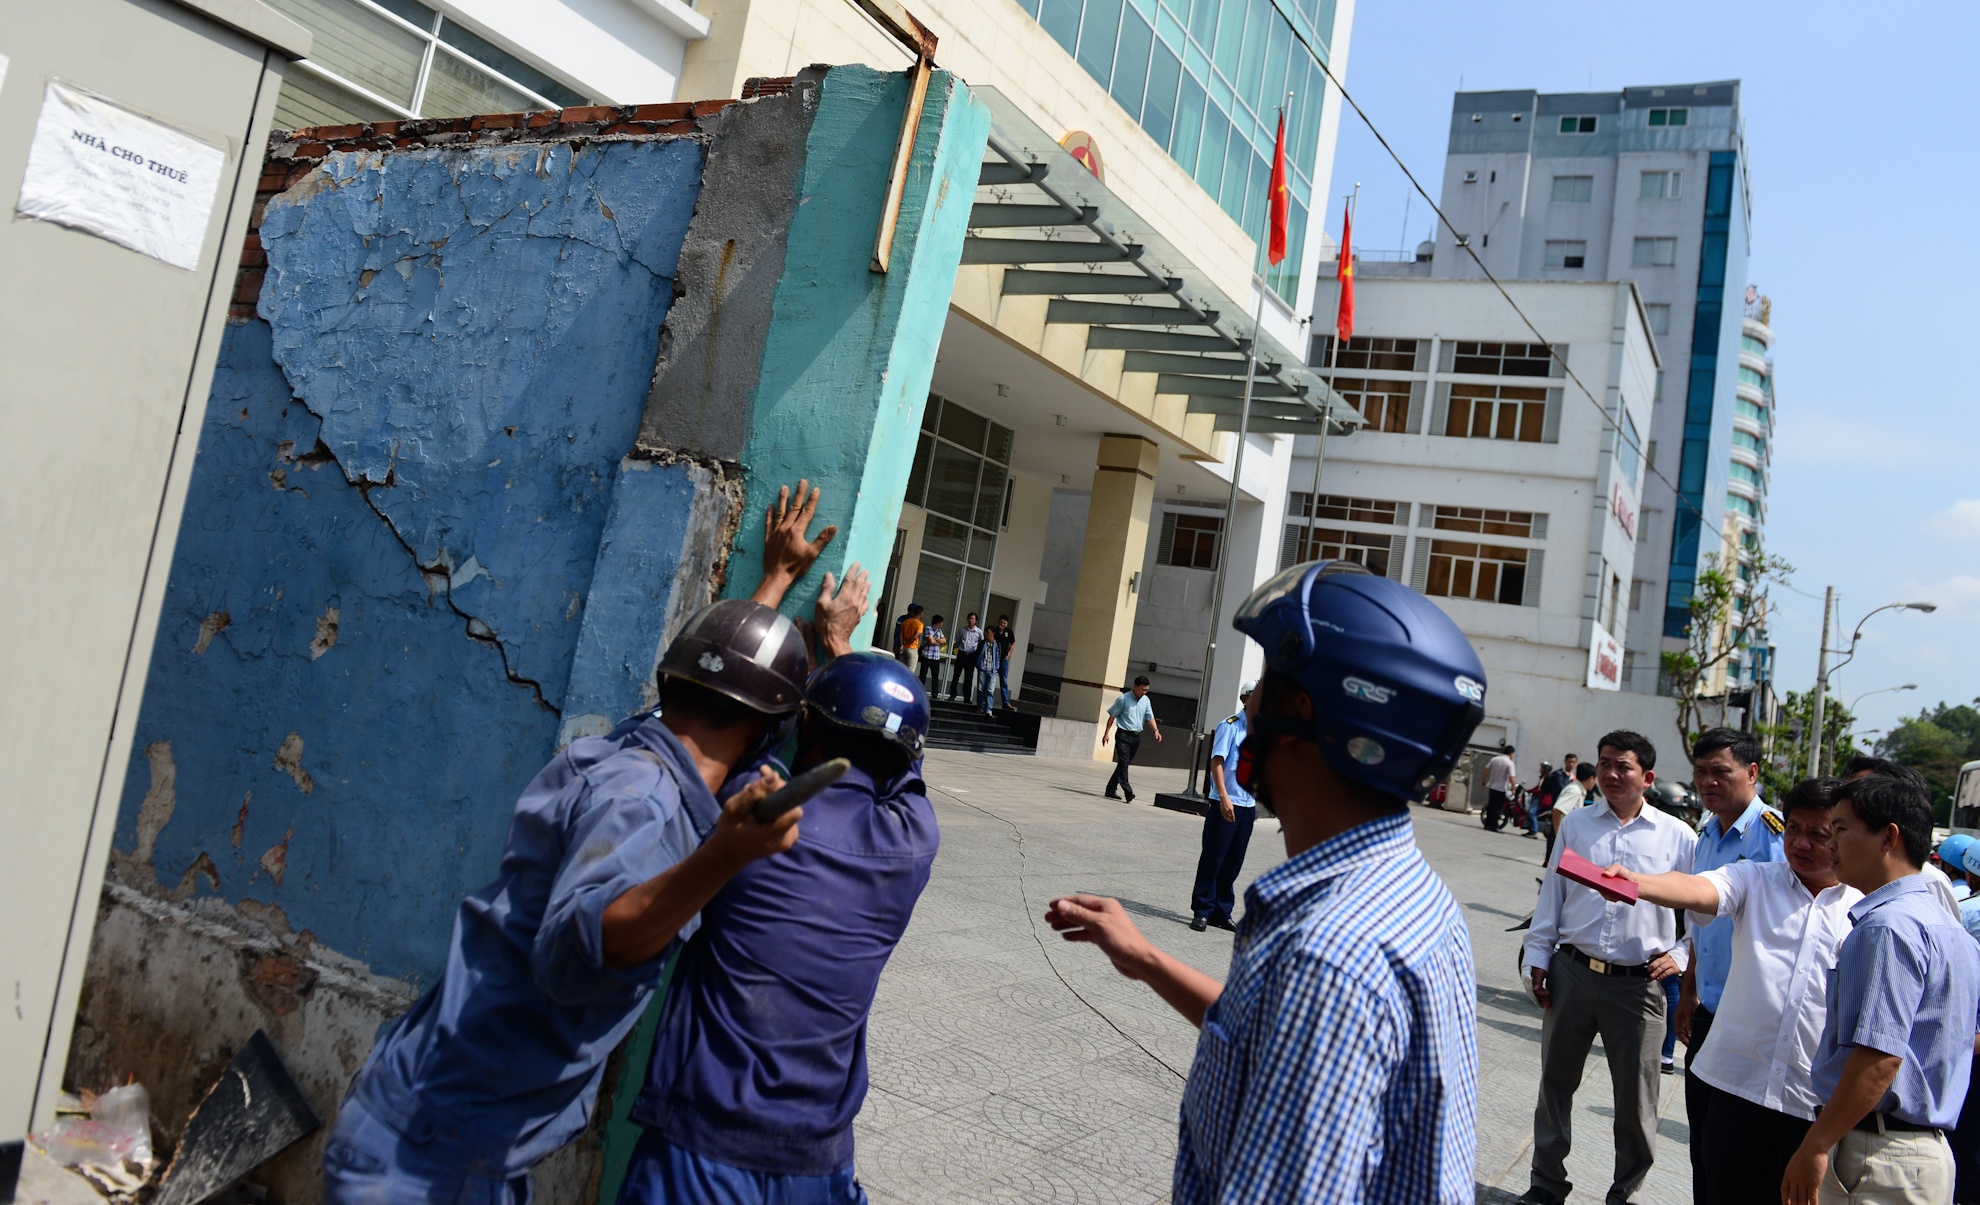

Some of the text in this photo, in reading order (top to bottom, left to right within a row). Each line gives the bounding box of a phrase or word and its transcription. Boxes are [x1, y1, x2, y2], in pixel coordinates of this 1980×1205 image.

[111, 146, 144, 165] CHO
[147, 159, 189, 184] THUÊ
[888, 685, 910, 699] Asia
[1342, 676, 1389, 704] GRS
[1454, 674, 1485, 701] GRS
